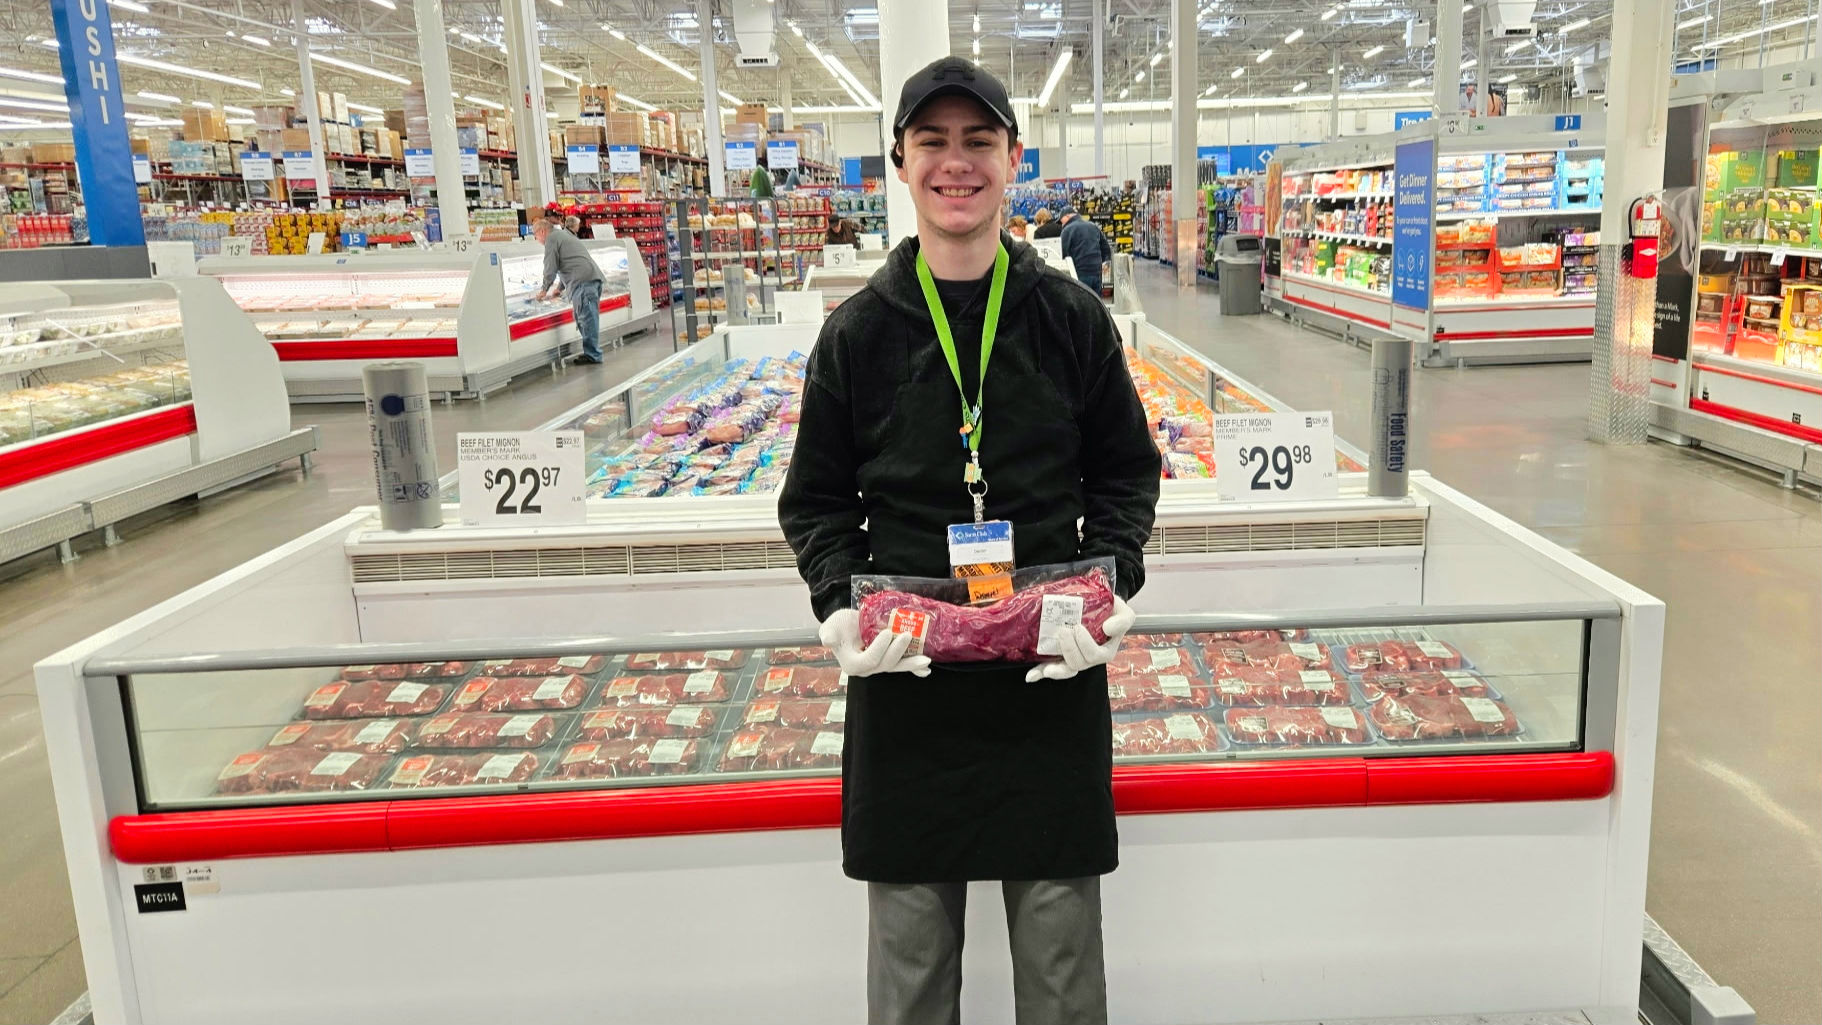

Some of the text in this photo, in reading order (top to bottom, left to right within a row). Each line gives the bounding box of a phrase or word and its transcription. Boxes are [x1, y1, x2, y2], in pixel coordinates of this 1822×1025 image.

[1400, 172, 1427, 188] Get Dinner
[1400, 190, 1426, 205] Delivered.
[349, 233, 360, 245] J5
[1231, 419, 1248, 427] FILET
[1248, 418, 1272, 427] MIGNON
[1391, 413, 1407, 436] Food
[460, 438, 520, 447] BEEF FILET MIGNON
[1387, 439, 1405, 473] Safety
[142, 892, 178, 904] MTC11A
